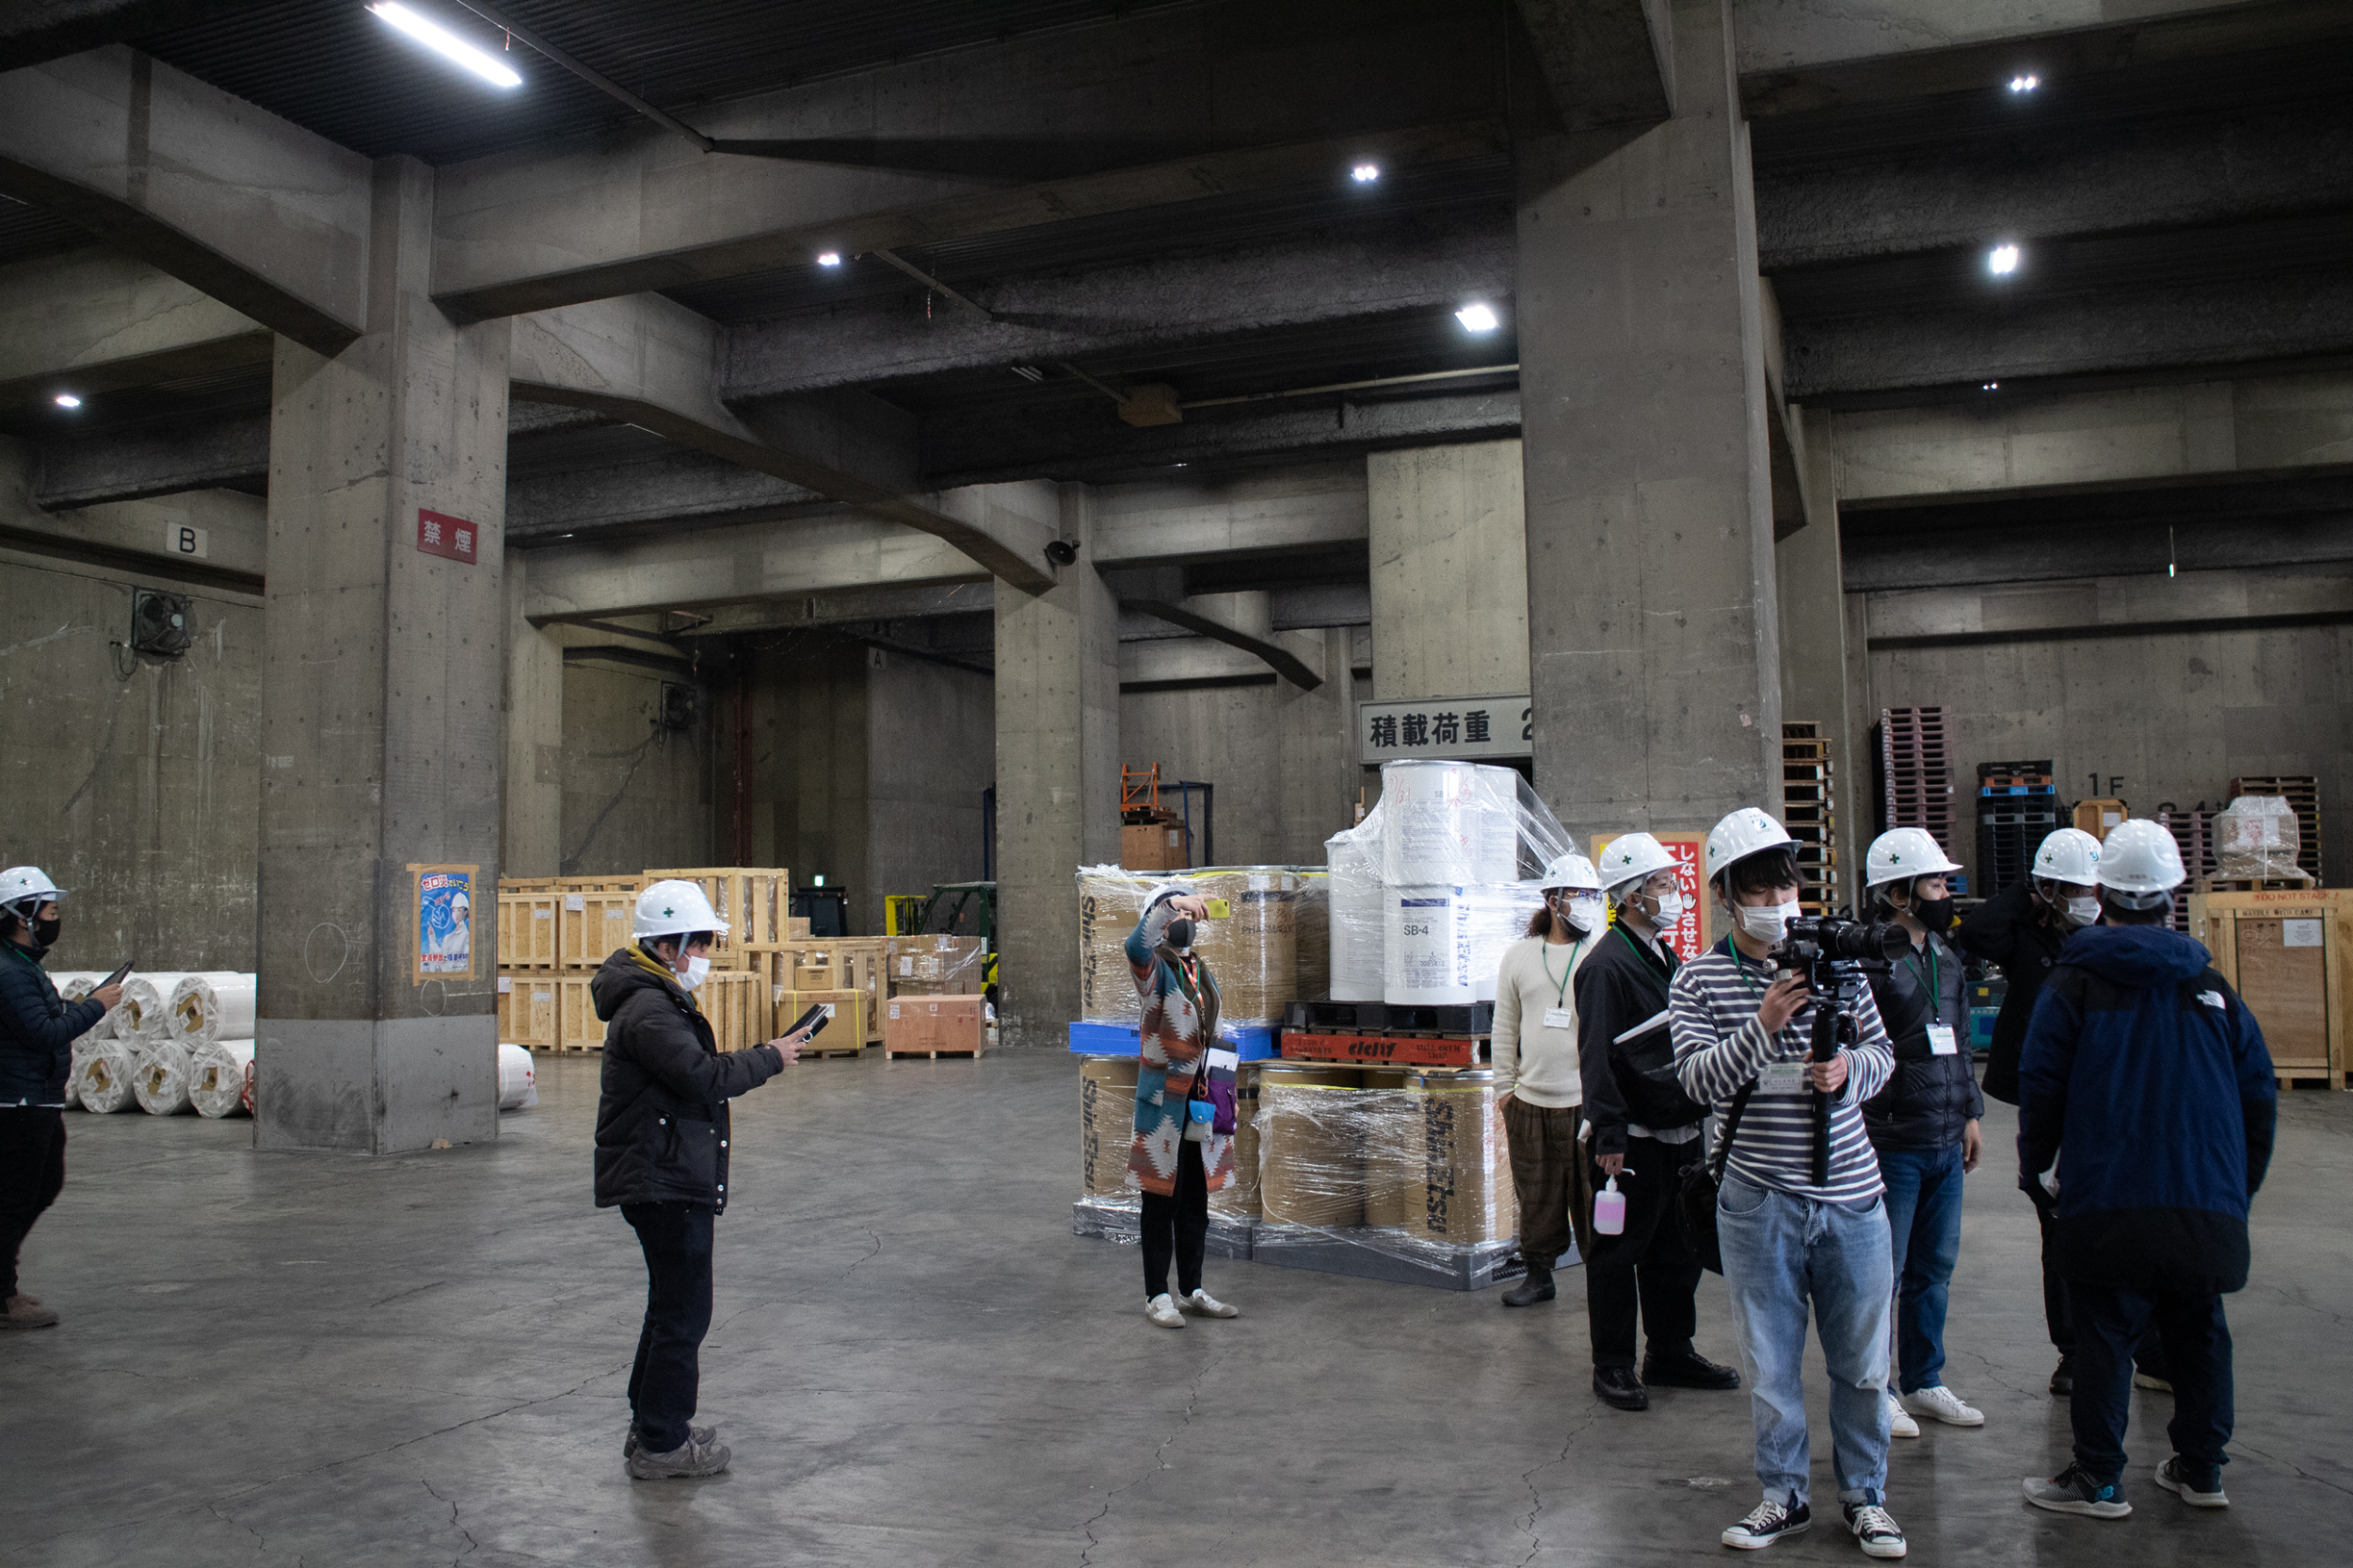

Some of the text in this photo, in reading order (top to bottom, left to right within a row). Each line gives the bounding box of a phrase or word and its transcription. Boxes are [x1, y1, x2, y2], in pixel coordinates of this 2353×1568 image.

[179, 526, 196, 554] B
[424, 520, 472, 552] 禁煙
[874, 649, 883, 668] A
[1369, 710, 1491, 748] 積載荷重
[1680, 845, 1698, 965] しない させな
[2261, 892, 2276, 901] DO
[2278, 892, 2297, 901] NOT
[2299, 891, 2330, 901] STACK
[1403, 924, 1430, 936] SB-4
